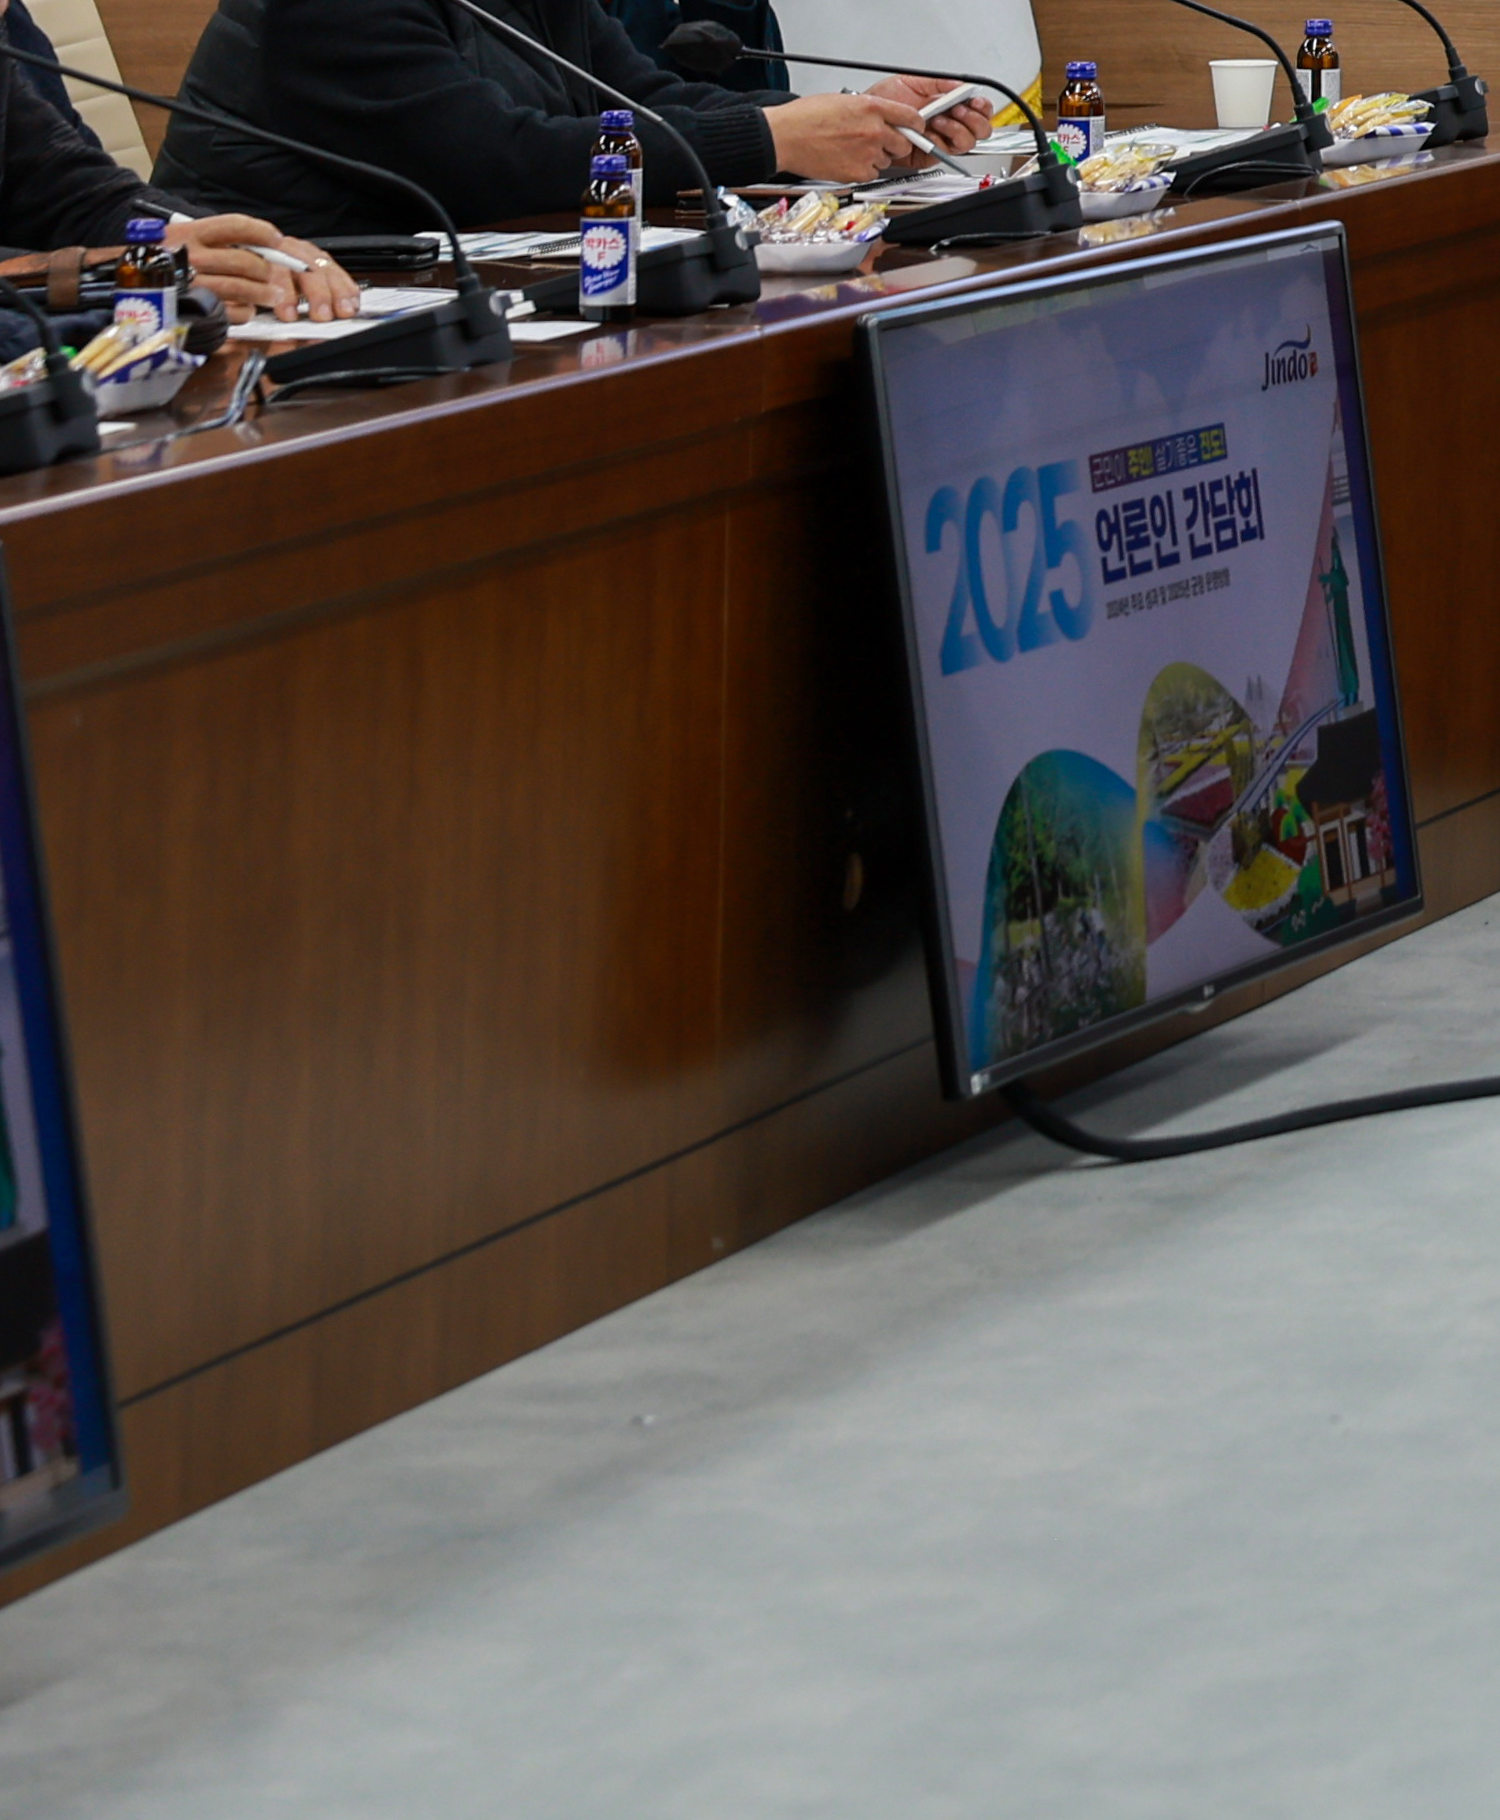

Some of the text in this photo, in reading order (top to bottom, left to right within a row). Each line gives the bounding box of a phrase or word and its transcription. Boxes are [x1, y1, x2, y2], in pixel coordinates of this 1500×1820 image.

[1261, 348, 1308, 392] Jindo
[924, 459, 1092, 677] 2025
[1095, 467, 1266, 586] 언론인 간담회
